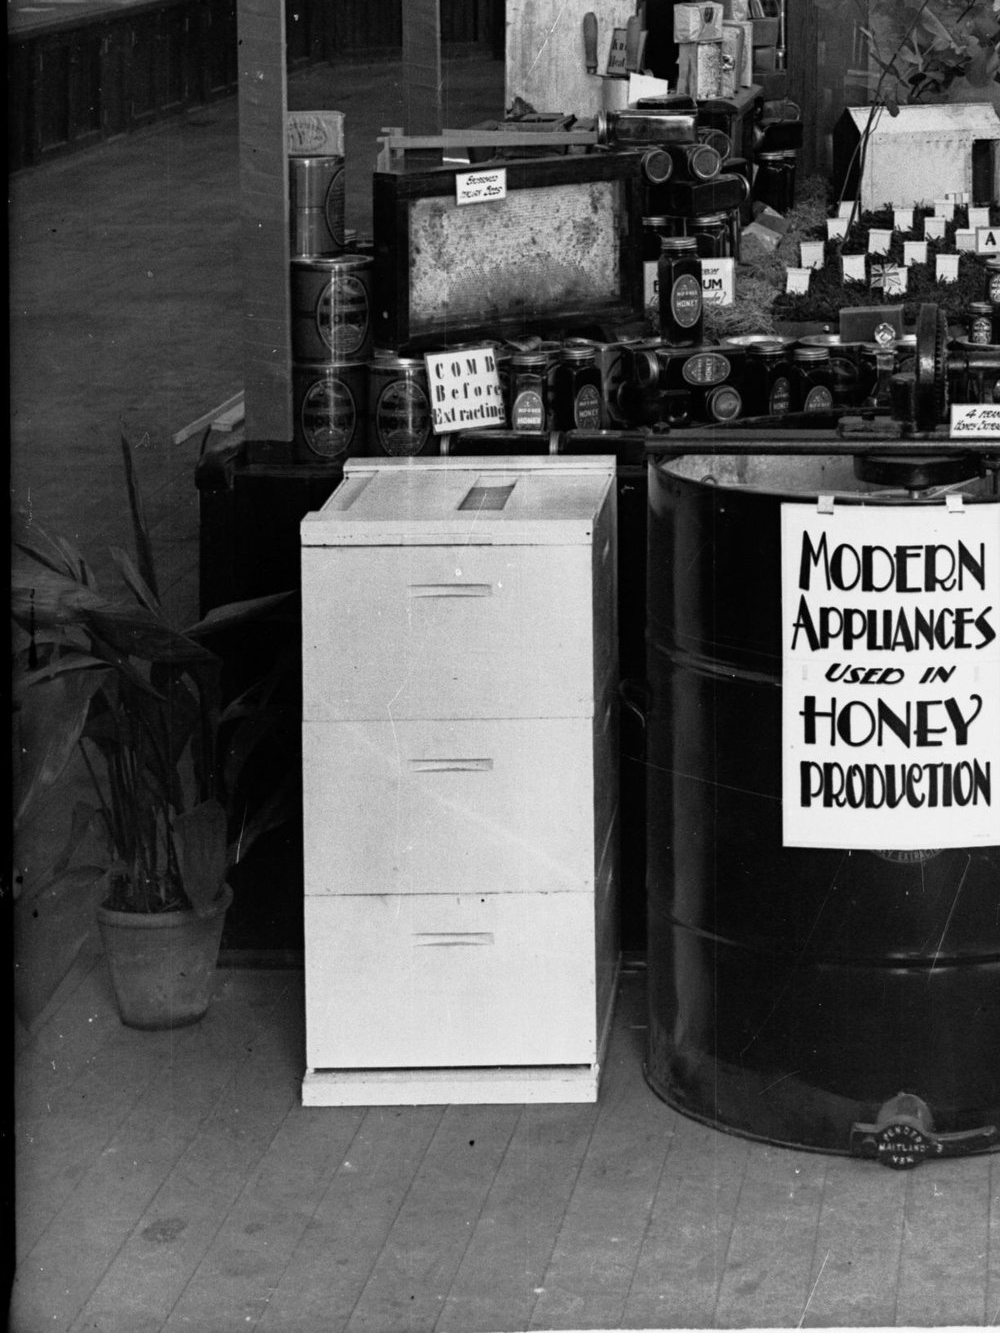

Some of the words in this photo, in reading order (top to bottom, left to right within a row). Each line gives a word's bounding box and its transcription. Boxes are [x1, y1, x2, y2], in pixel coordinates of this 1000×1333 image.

[985, 231, 996, 245] A
[676, 299, 698, 307] HONEY
[436, 355, 496, 379] COMB
[436, 383, 500, 403] Before
[517, 417, 541, 425] HONEY
[579, 409, 598, 417] HONEY
[966, 409, 976, 419] 4
[799, 530, 985, 593] MODERN
[791, 594, 996, 652] APPLIANCES
[824, 663, 904, 685] USED
[919, 665, 957, 684] IN
[799, 694, 982, 749] HONEY
[800, 758, 990, 809] PRODUCTION
